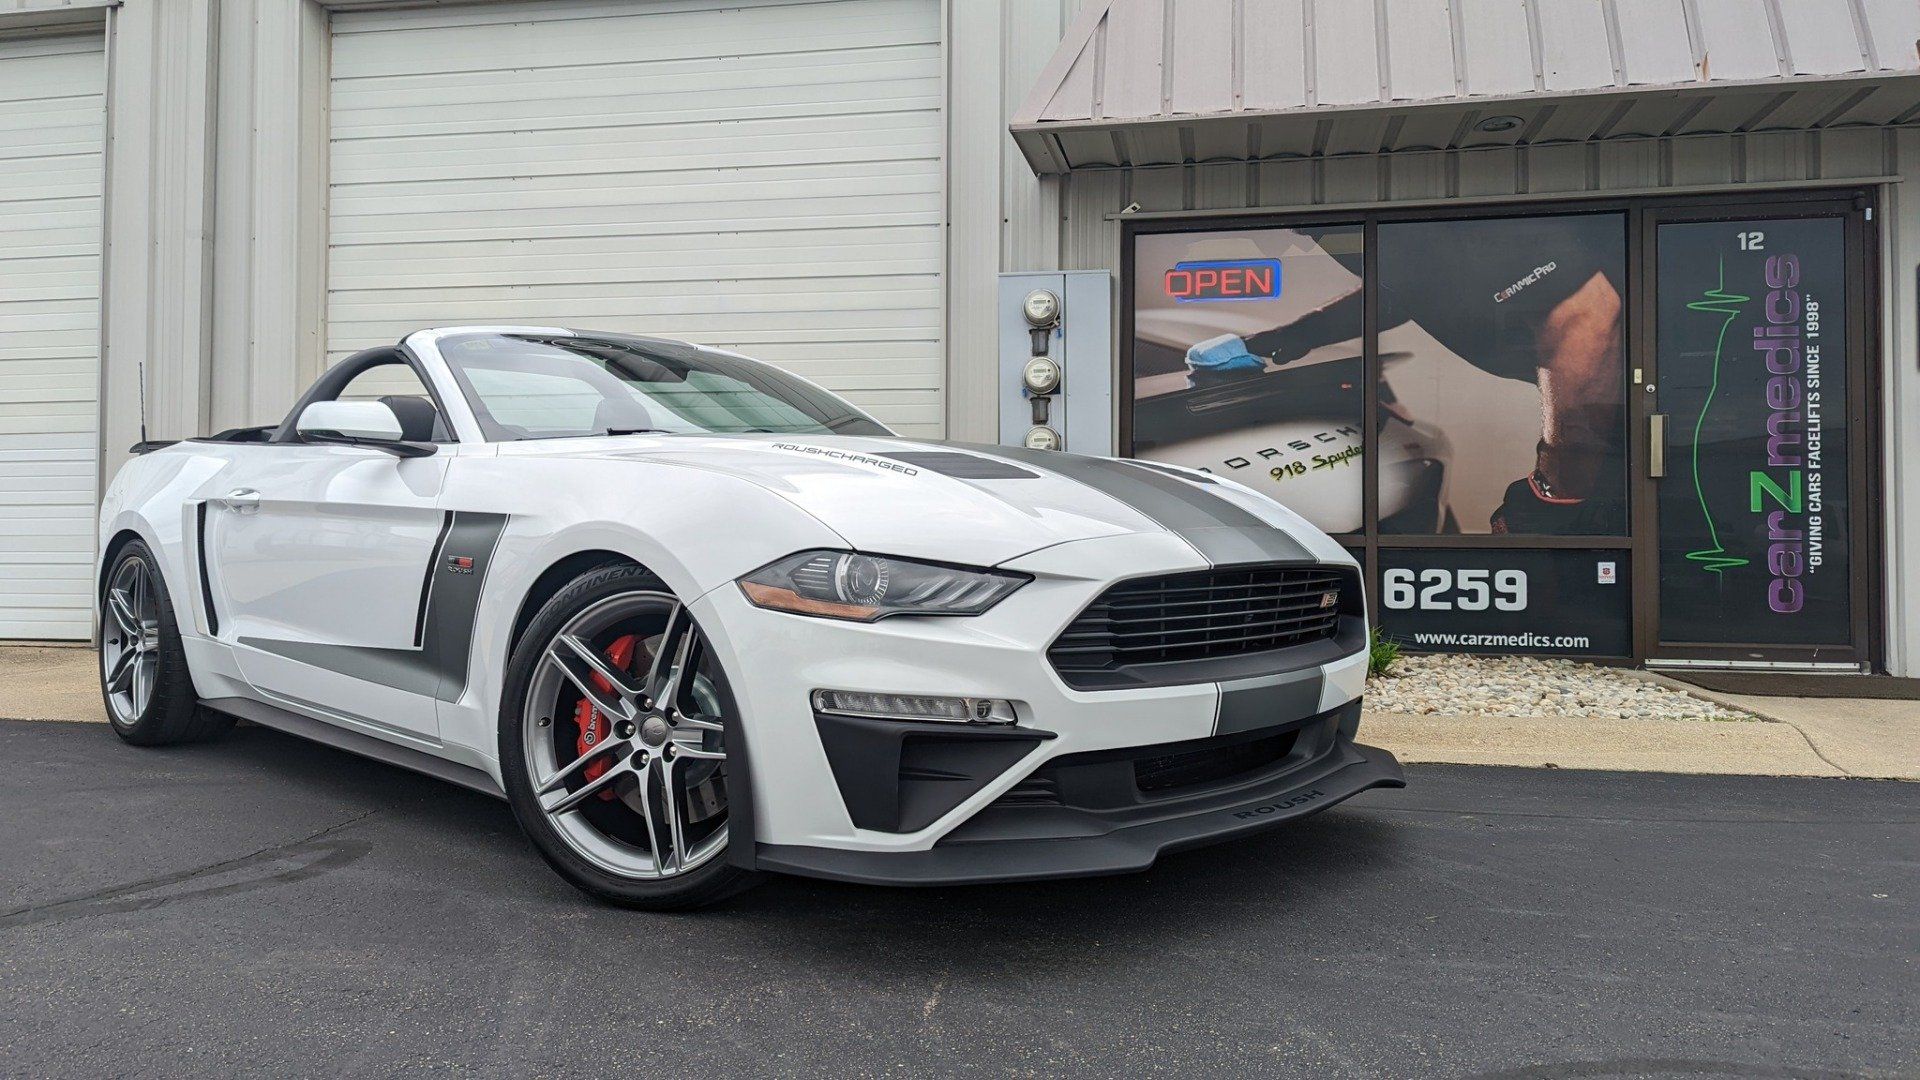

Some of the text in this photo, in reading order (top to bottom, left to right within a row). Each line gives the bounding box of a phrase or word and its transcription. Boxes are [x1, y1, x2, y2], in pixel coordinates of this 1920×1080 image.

[1737, 231, 1765, 251] 12
[1164, 268, 1271, 297] OPEN
[1806, 345, 1820, 389] SINCE
[1197, 422, 1361, 474] ORSCH
[1807, 392, 1822, 469] FACELIFTS
[1270, 460, 1306, 481] 918
[1808, 472, 1823, 512] CARS
[1383, 568, 1528, 612] 6259
[1415, 632, 1590, 648] www.carzmedics.com
[1232, 789, 1325, 820] ROUSH
